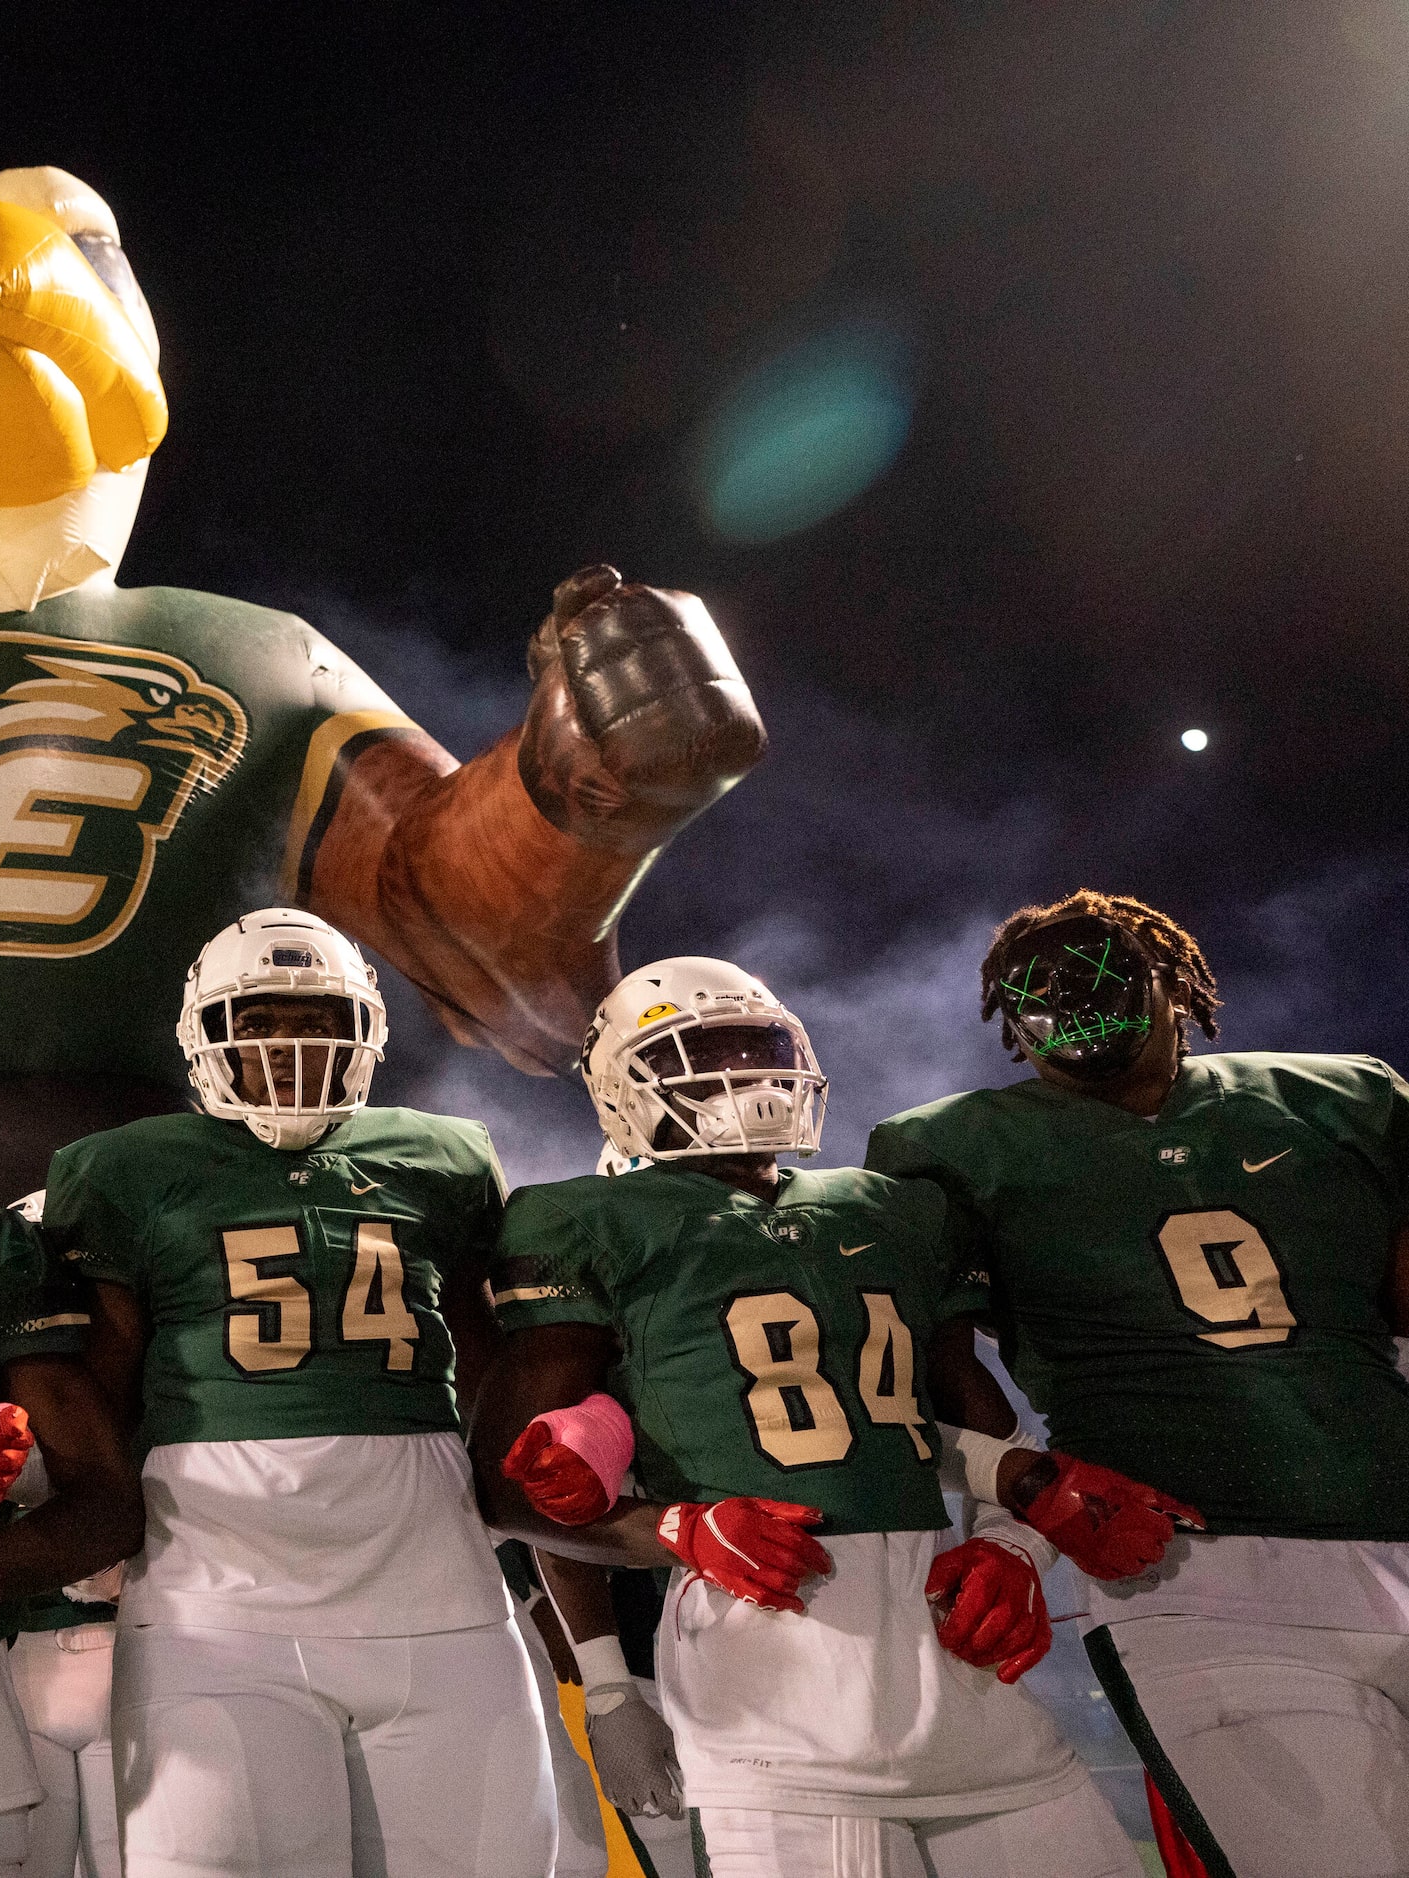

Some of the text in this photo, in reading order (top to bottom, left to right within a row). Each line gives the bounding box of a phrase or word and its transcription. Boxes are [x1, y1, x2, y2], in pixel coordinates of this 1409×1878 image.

[221, 1221, 422, 1375] 54
[1157, 1209, 1300, 1351] 9
[725, 1291, 935, 1470] 84
